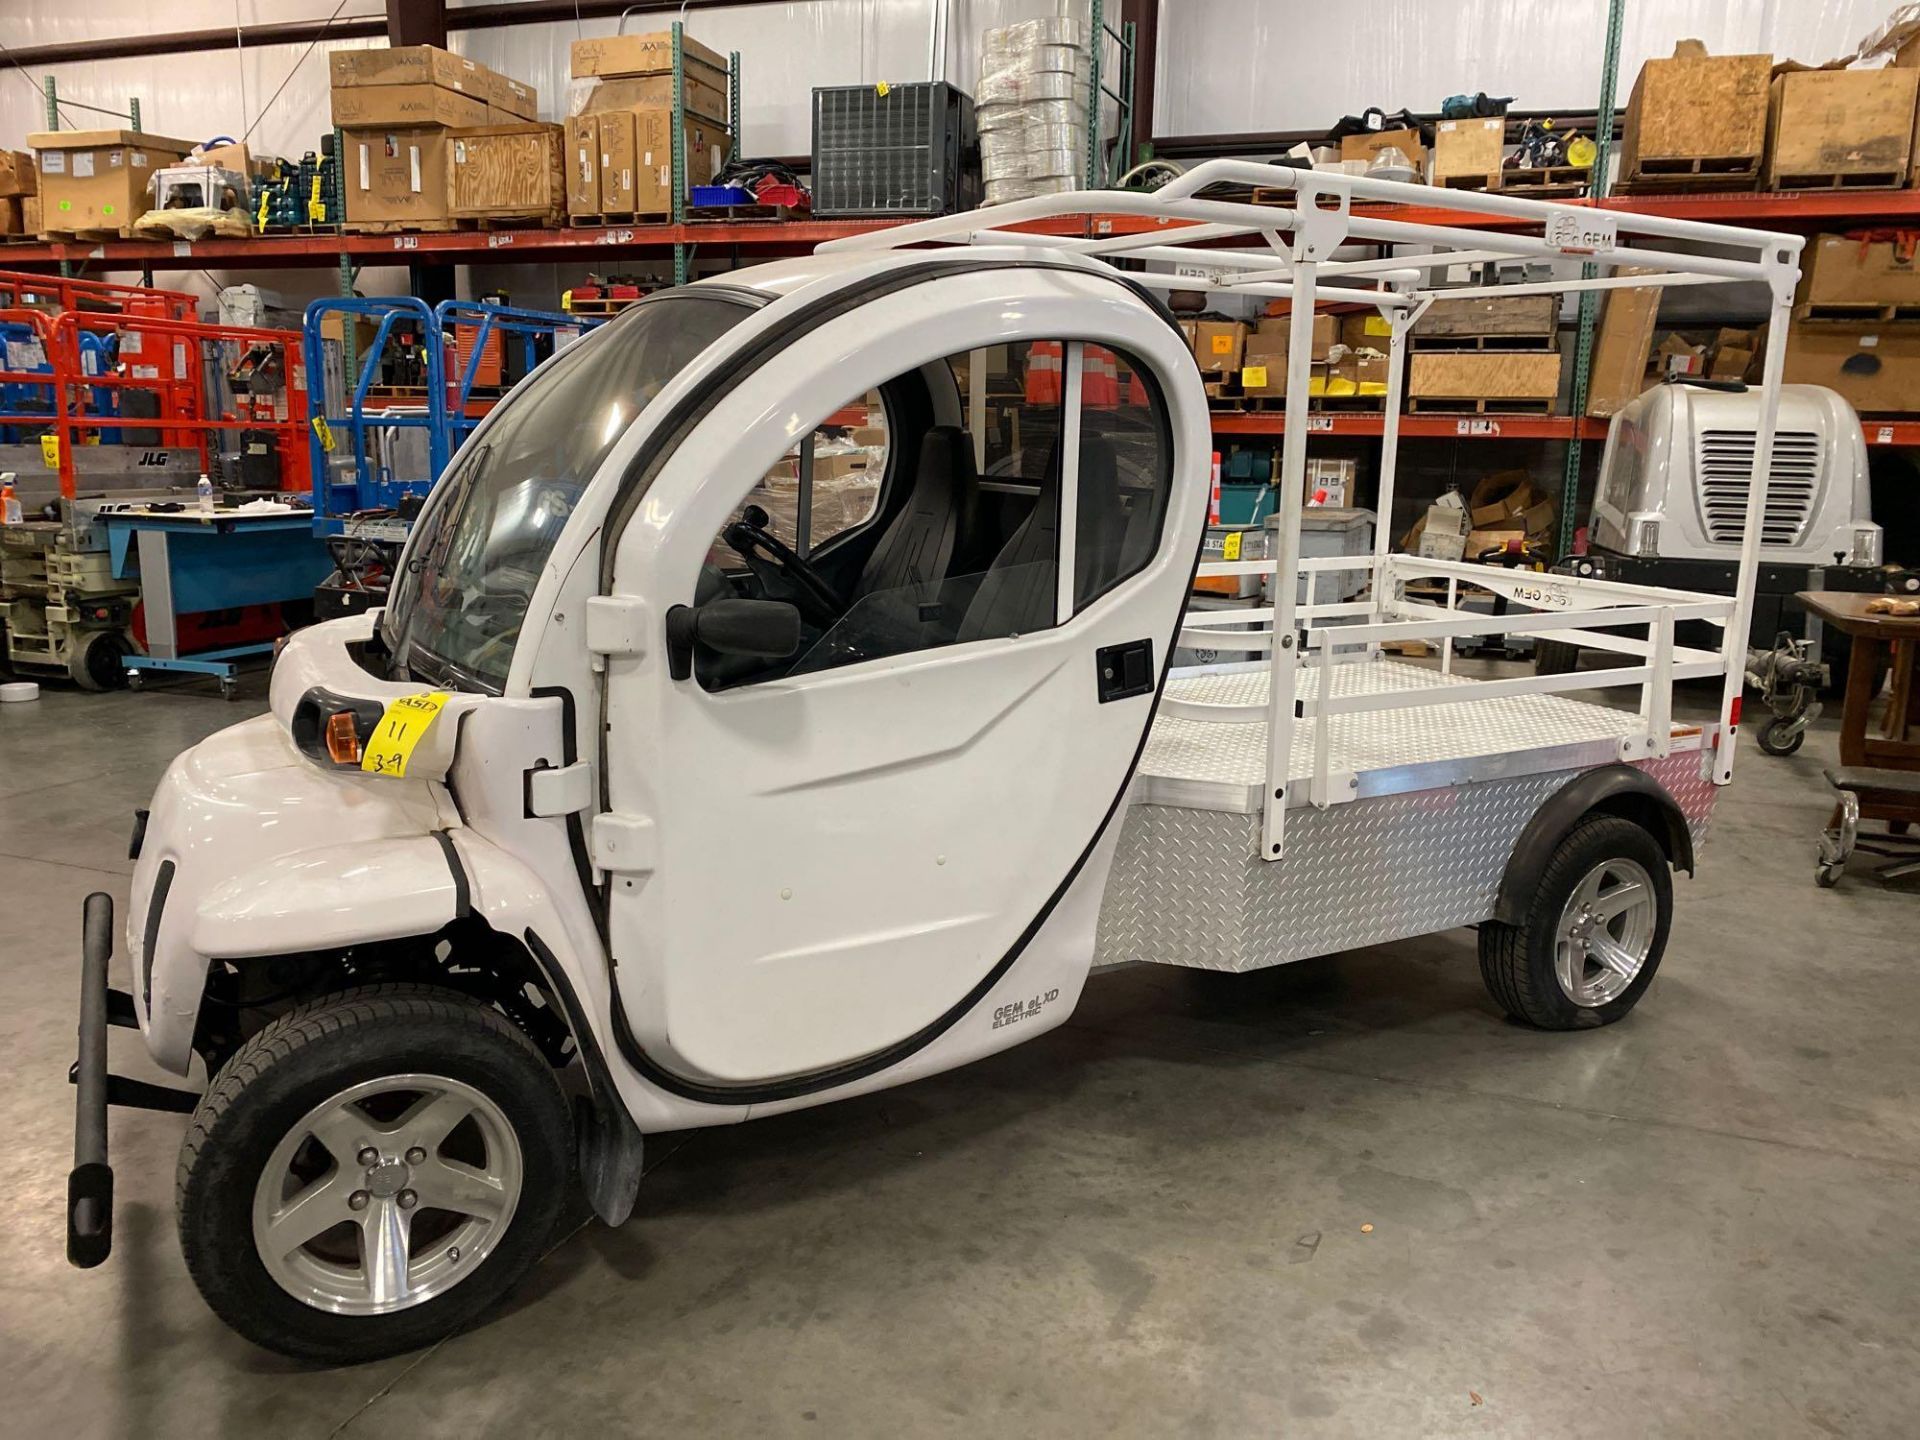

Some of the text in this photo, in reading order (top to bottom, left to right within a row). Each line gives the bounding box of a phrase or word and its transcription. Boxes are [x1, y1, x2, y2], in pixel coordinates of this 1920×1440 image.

[1582, 231, 1612, 246] GEM
[138, 452, 169, 466] JLG
[992, 1006, 1042, 1029] ELECTRIC
[993, 1001, 1023, 1020] GEM
